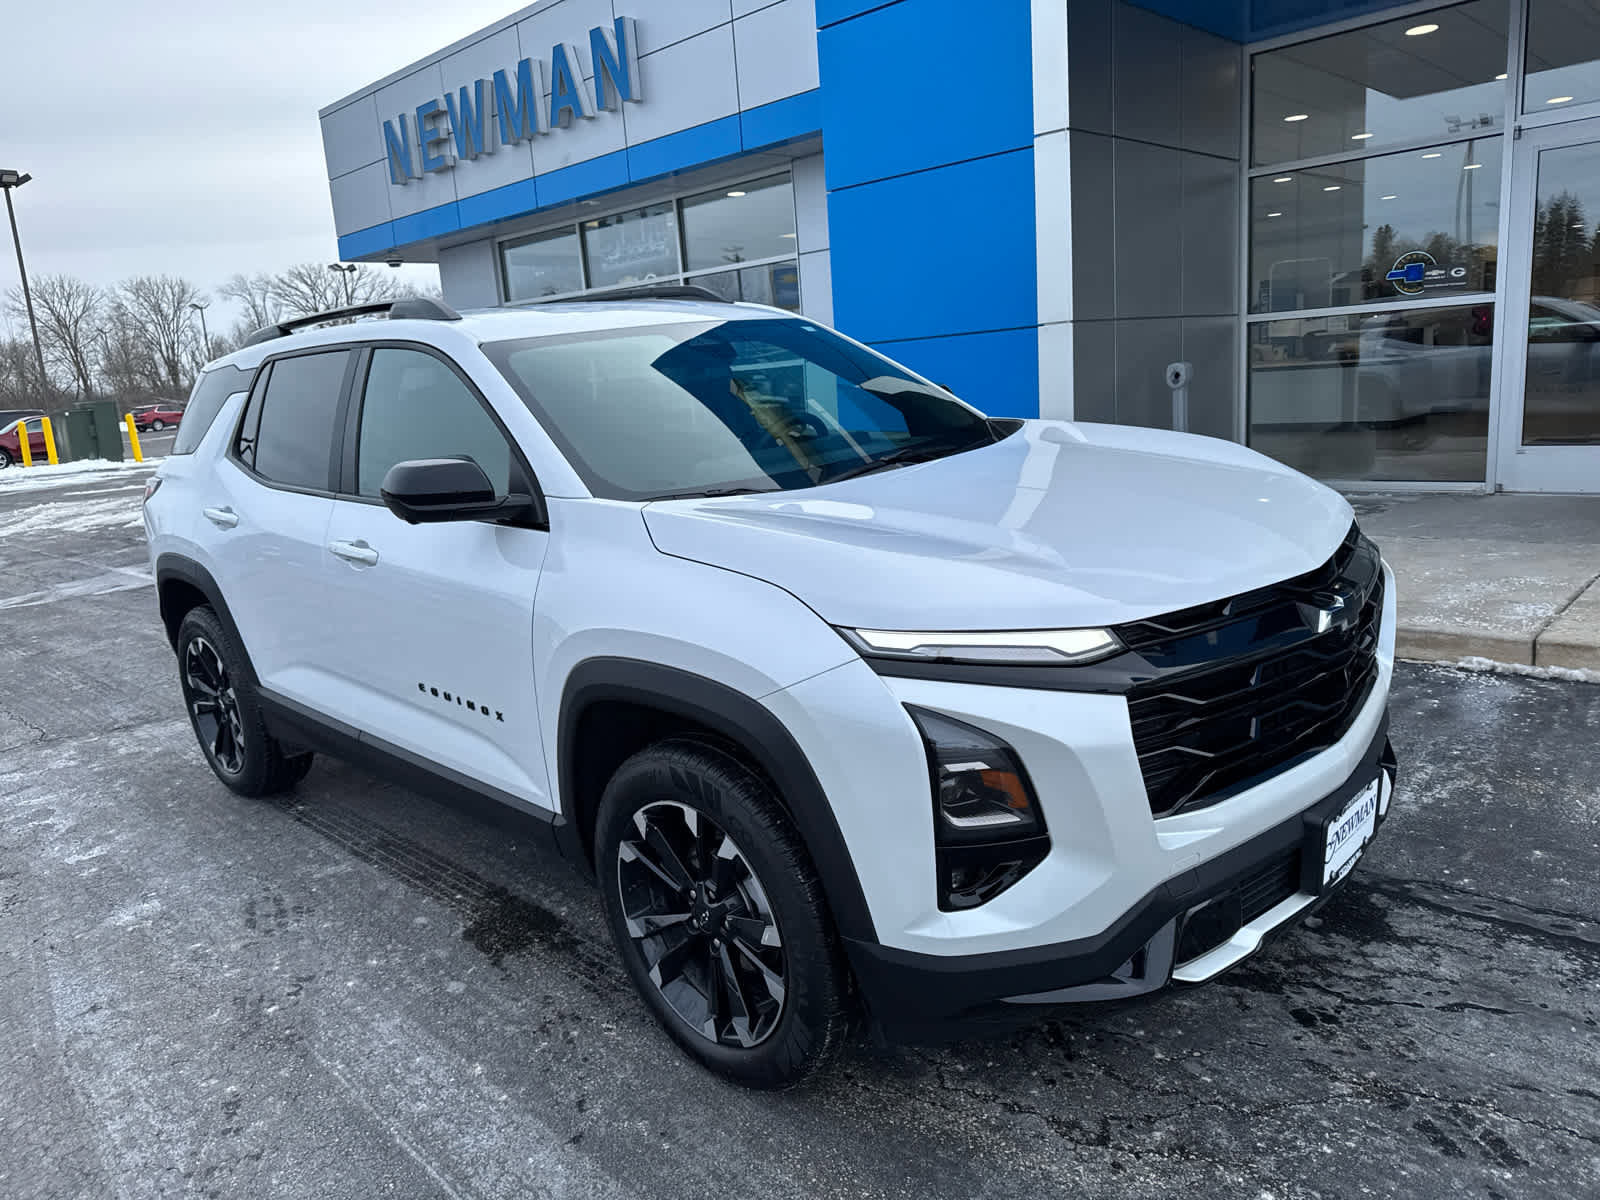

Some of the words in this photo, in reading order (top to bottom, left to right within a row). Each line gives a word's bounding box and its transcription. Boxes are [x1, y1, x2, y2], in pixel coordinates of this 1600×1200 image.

[383, 15, 640, 186] NEWMAN
[418, 682, 504, 722] EQUINOX
[1326, 795, 1377, 863] NEWMAN
